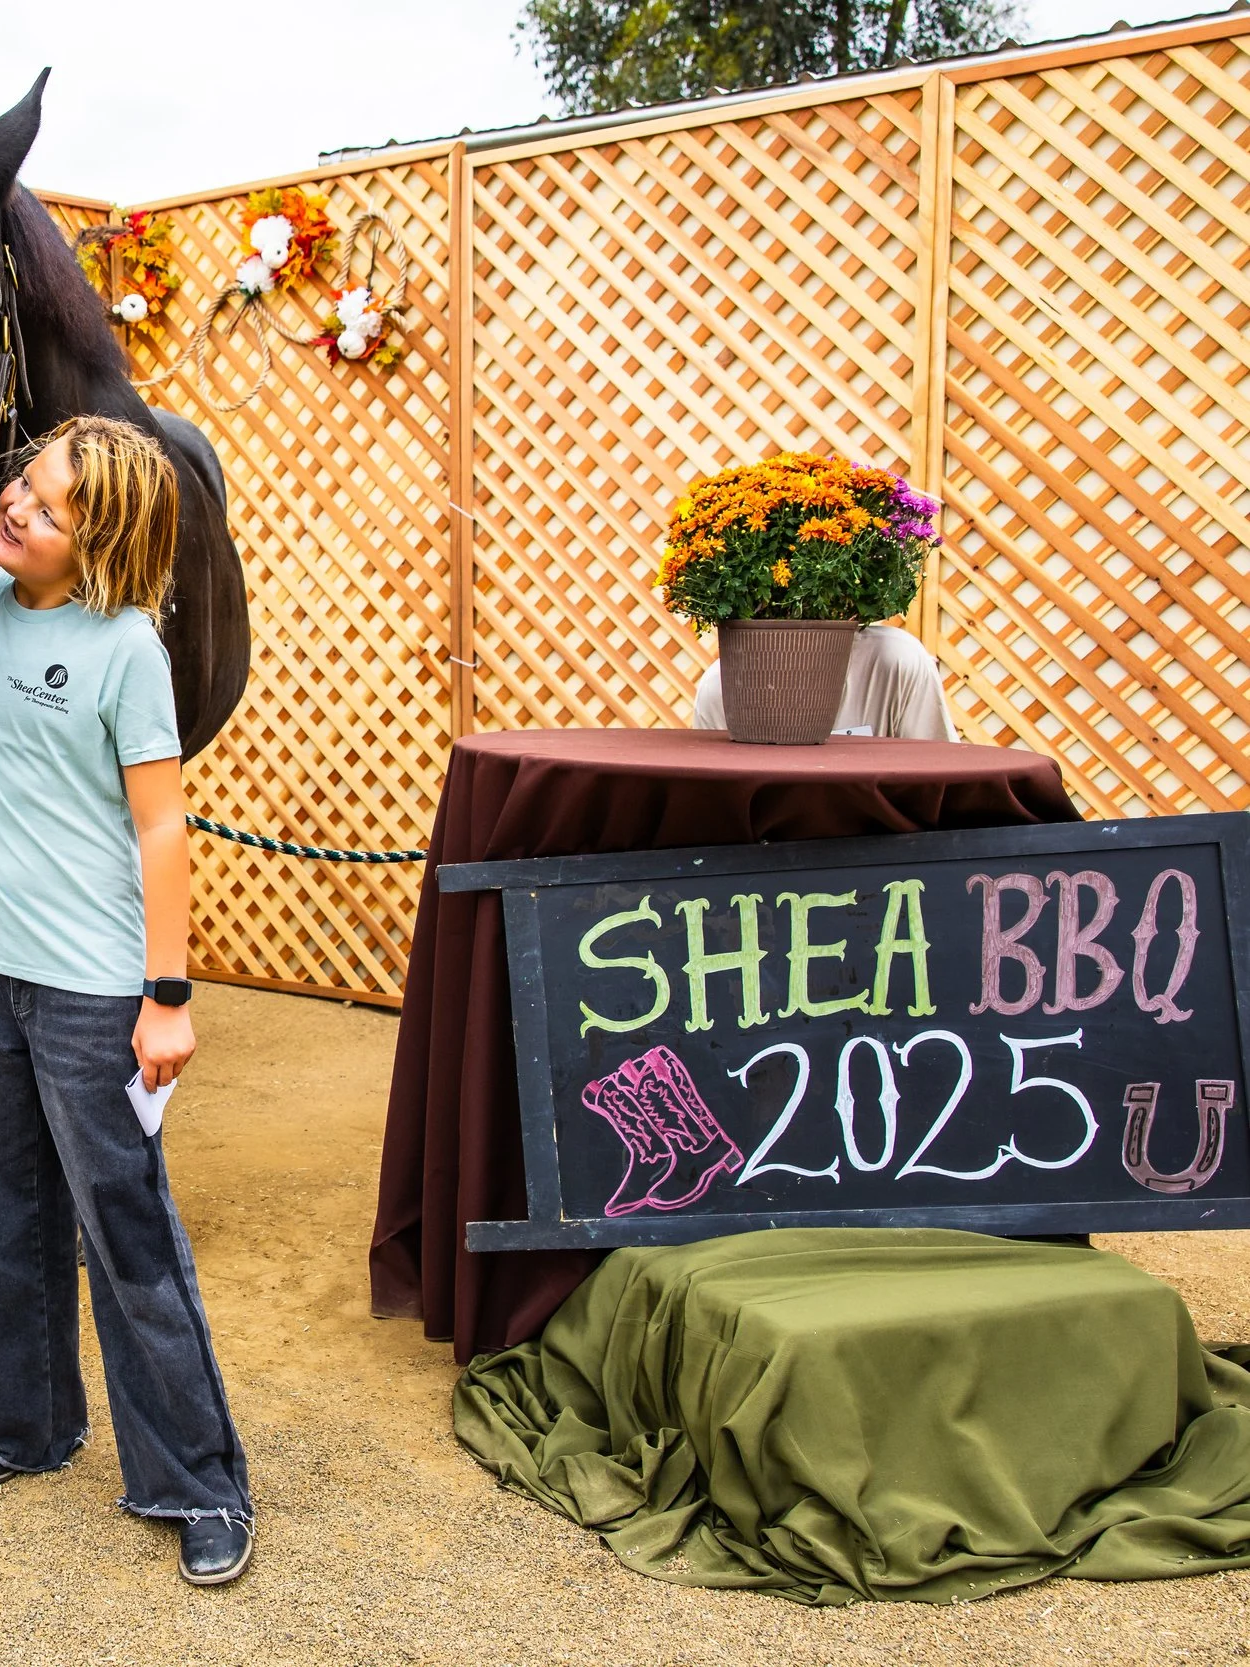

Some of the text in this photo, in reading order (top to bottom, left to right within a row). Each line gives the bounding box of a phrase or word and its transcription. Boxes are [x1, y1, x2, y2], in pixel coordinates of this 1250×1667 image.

[578, 868, 1200, 1038] SHEA BBQ
[726, 1026, 1101, 1187] 2025
